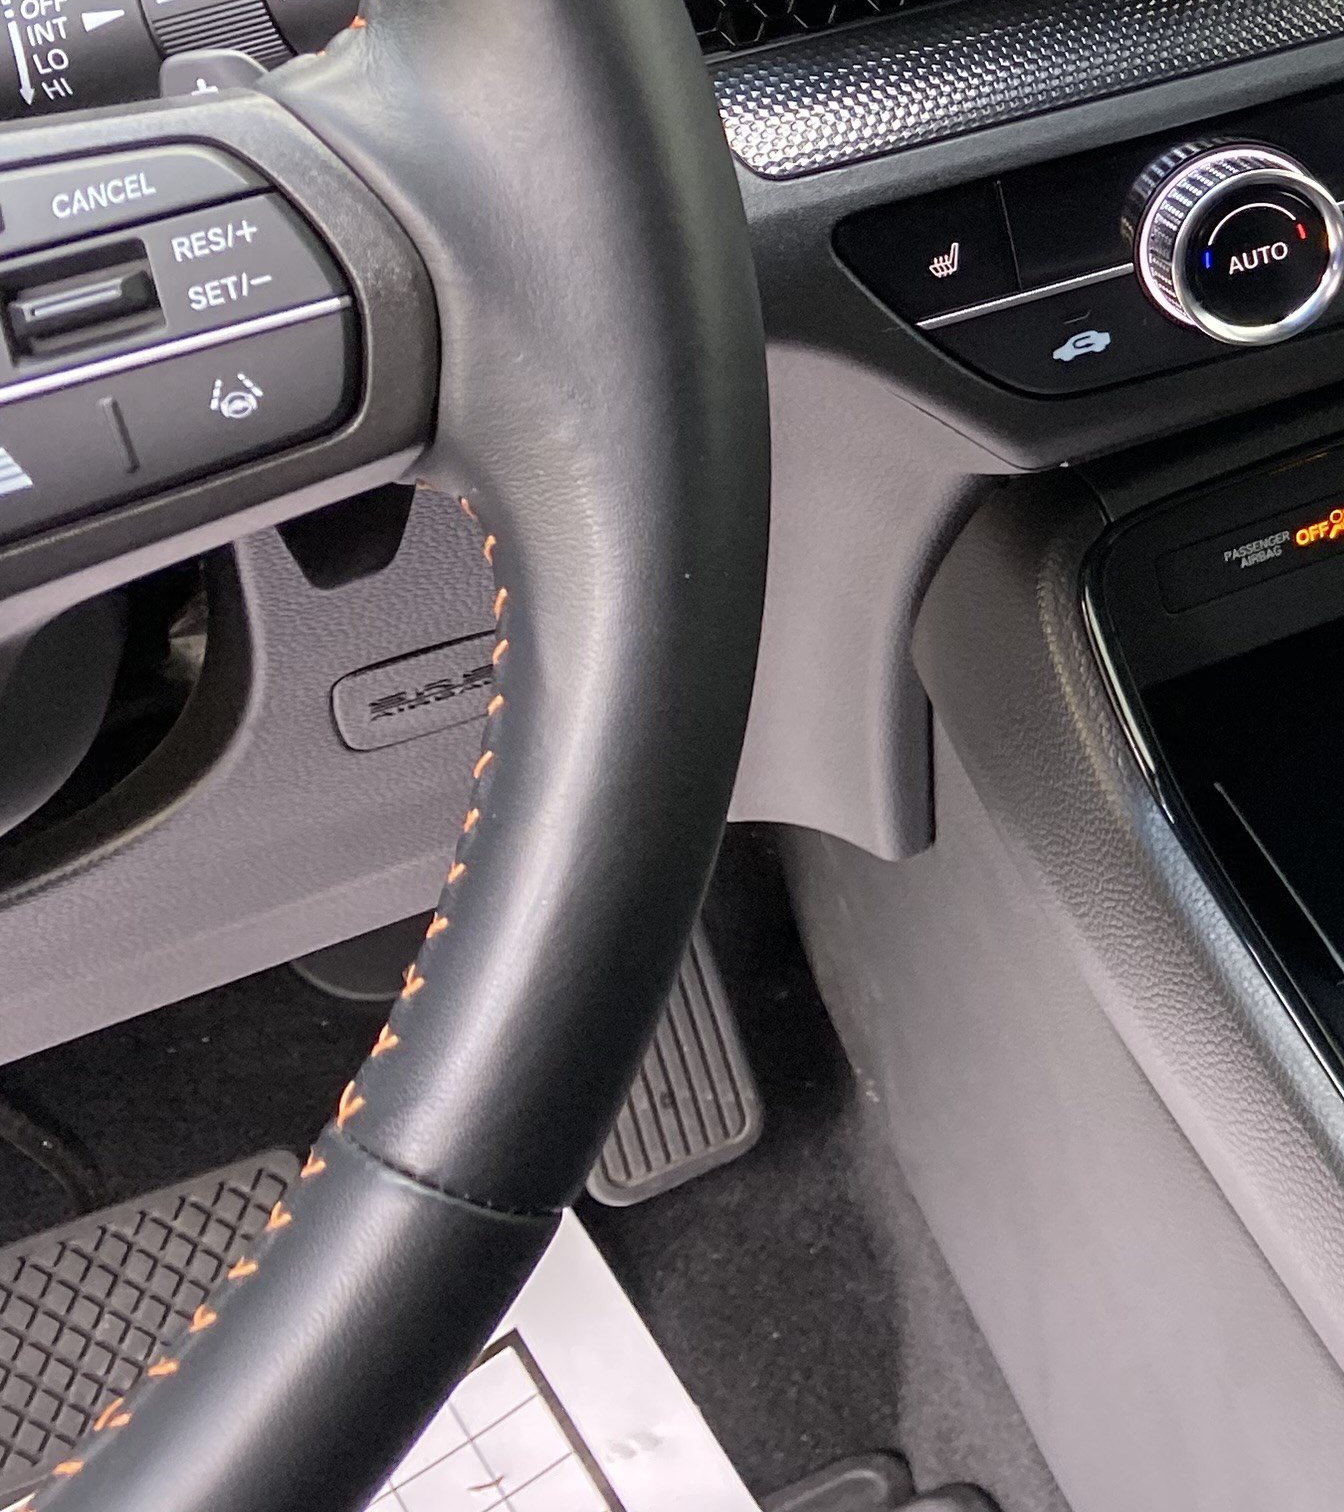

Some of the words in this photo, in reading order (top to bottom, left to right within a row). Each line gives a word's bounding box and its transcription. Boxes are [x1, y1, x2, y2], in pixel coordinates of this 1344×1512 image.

[26, 15, 68, 47] INT
[32, 47, 69, 75] LO
[41, 77, 74, 101] HI
[51, 172, 157, 219] CANCEL
[171, 219, 258, 262] RES/+
[1228, 240, 1290, 275] AUTO
[187, 272, 273, 311] SET/-
[1223, 530, 1291, 562] PASSENGER
[1295, 520, 1330, 546] OFF
[1240, 545, 1283, 569] AIRBAG
